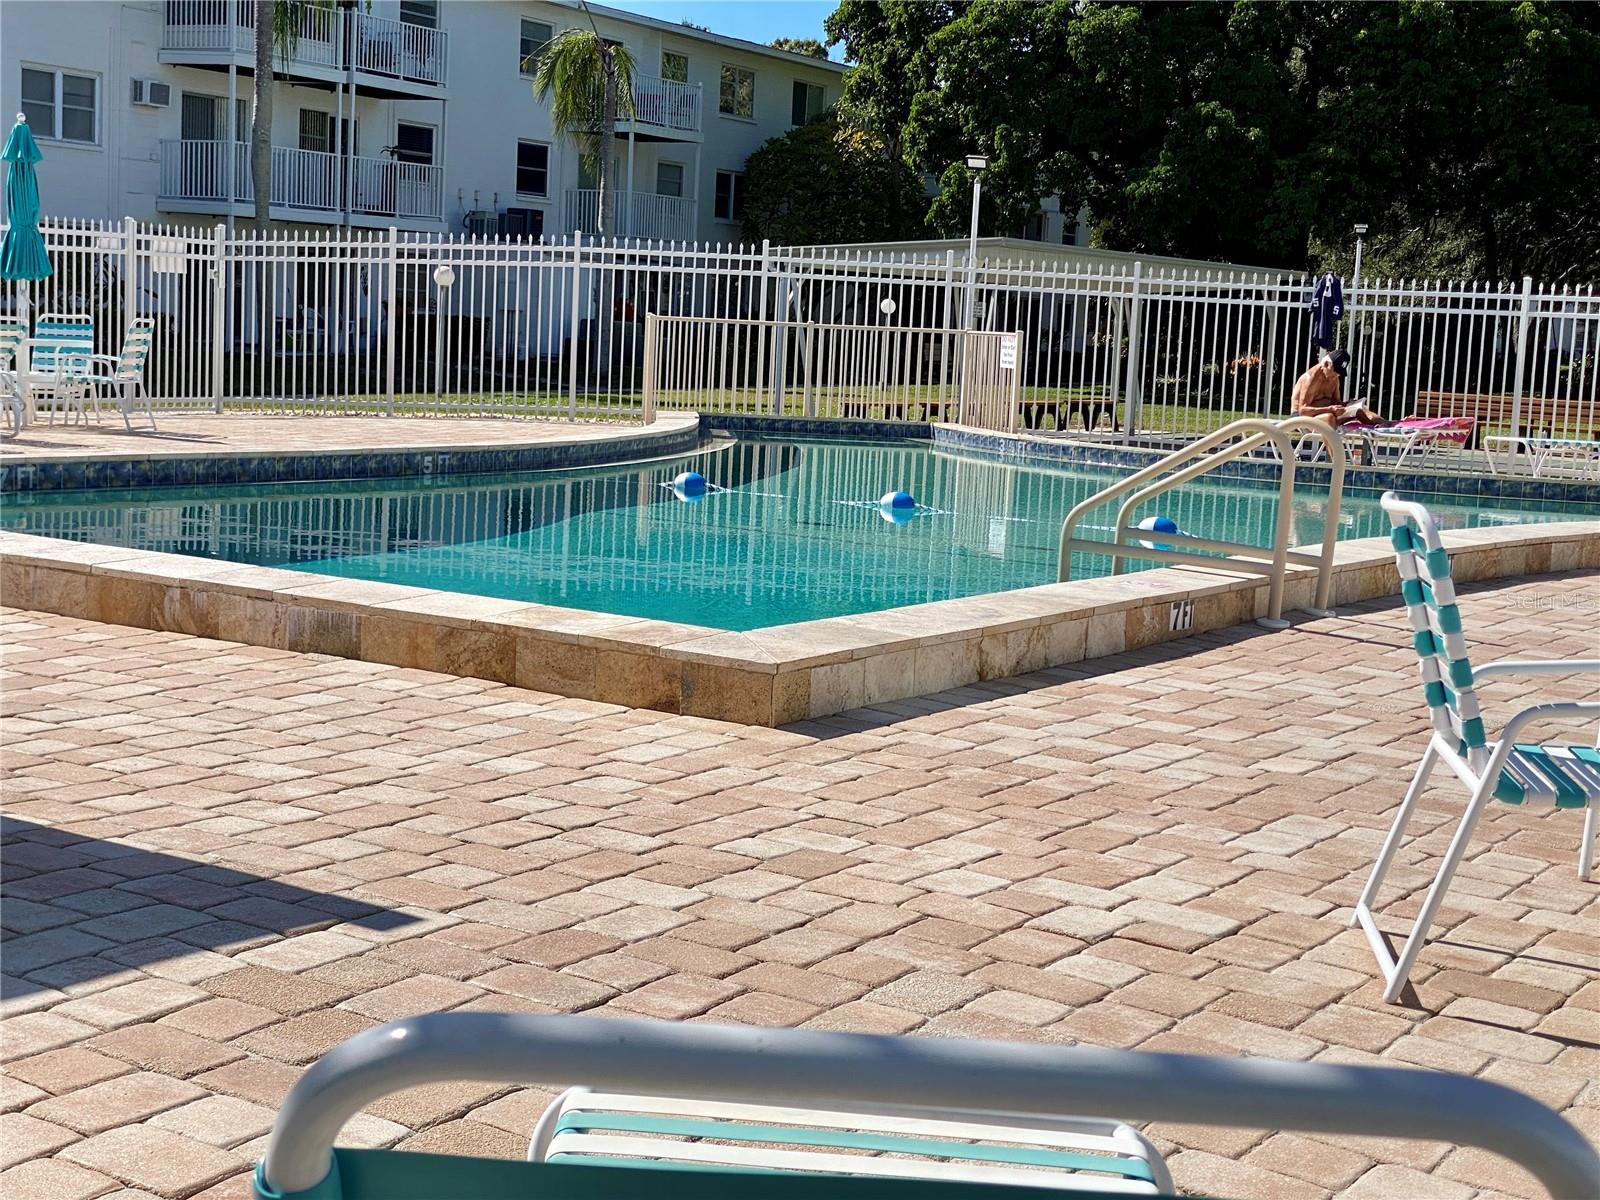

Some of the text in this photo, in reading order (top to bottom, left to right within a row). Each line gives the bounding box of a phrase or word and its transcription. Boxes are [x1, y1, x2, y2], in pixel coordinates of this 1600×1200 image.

[1333, 305, 1340, 315] 5
[423, 454, 450, 474] 5 FT
[17, 466, 36, 489] FT
